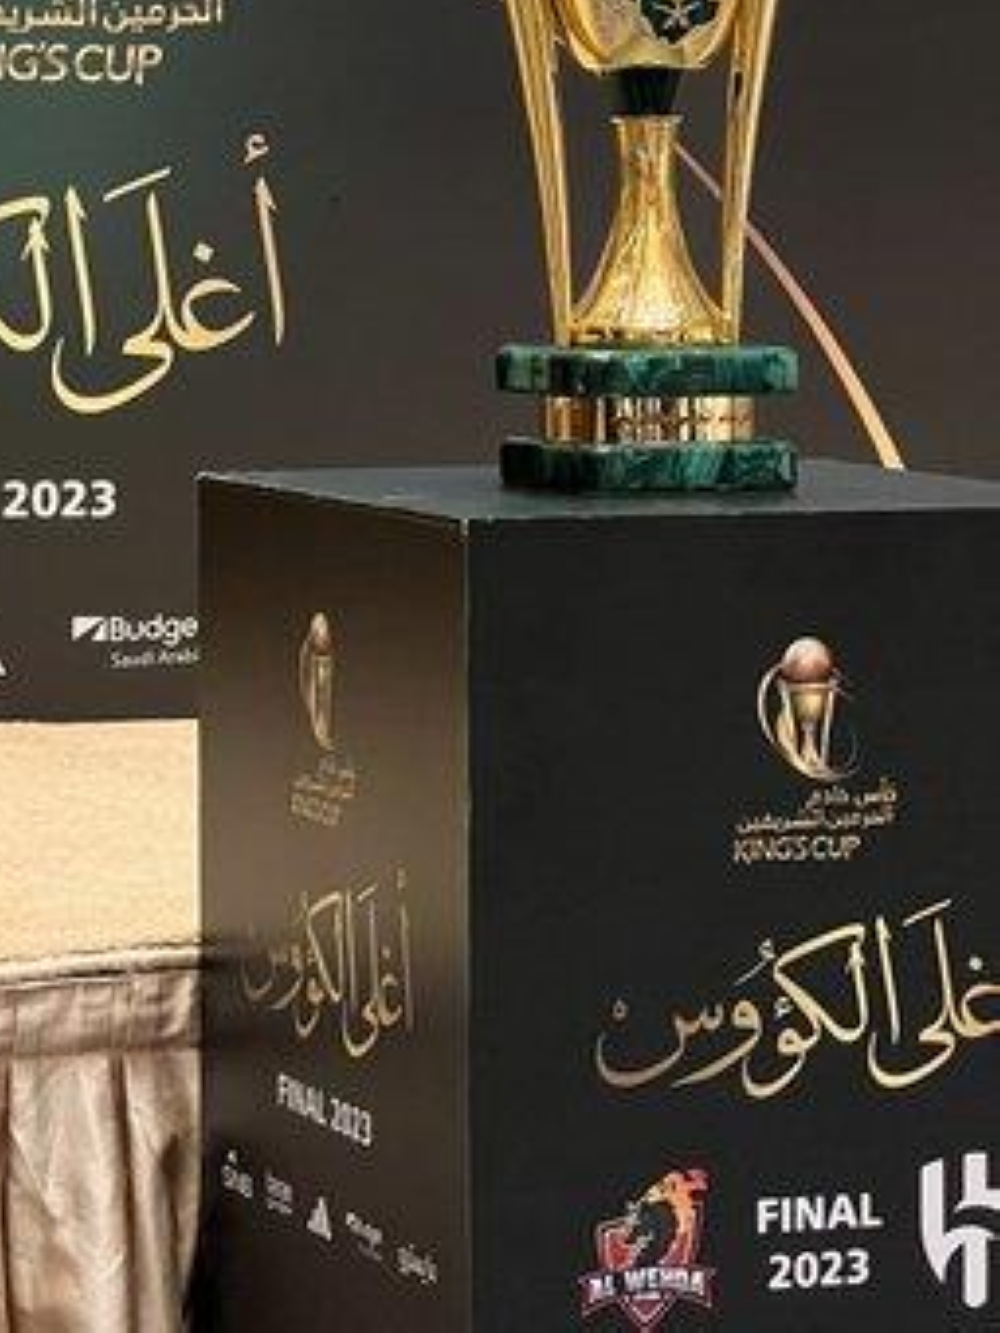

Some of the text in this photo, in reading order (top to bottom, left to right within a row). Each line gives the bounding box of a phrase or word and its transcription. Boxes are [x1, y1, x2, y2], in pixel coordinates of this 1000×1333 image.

[74, 43, 163, 85] CUP
[3, 480, 118, 519] 2023
[110, 613, 199, 647] Budge
[158, 649, 200, 666] Arabi
[811, 835, 861, 861] CUP
[277, 1072, 372, 1149] FINAL 2023
[756, 1193, 882, 1234] FINAL
[767, 1248, 870, 1289] 2023
